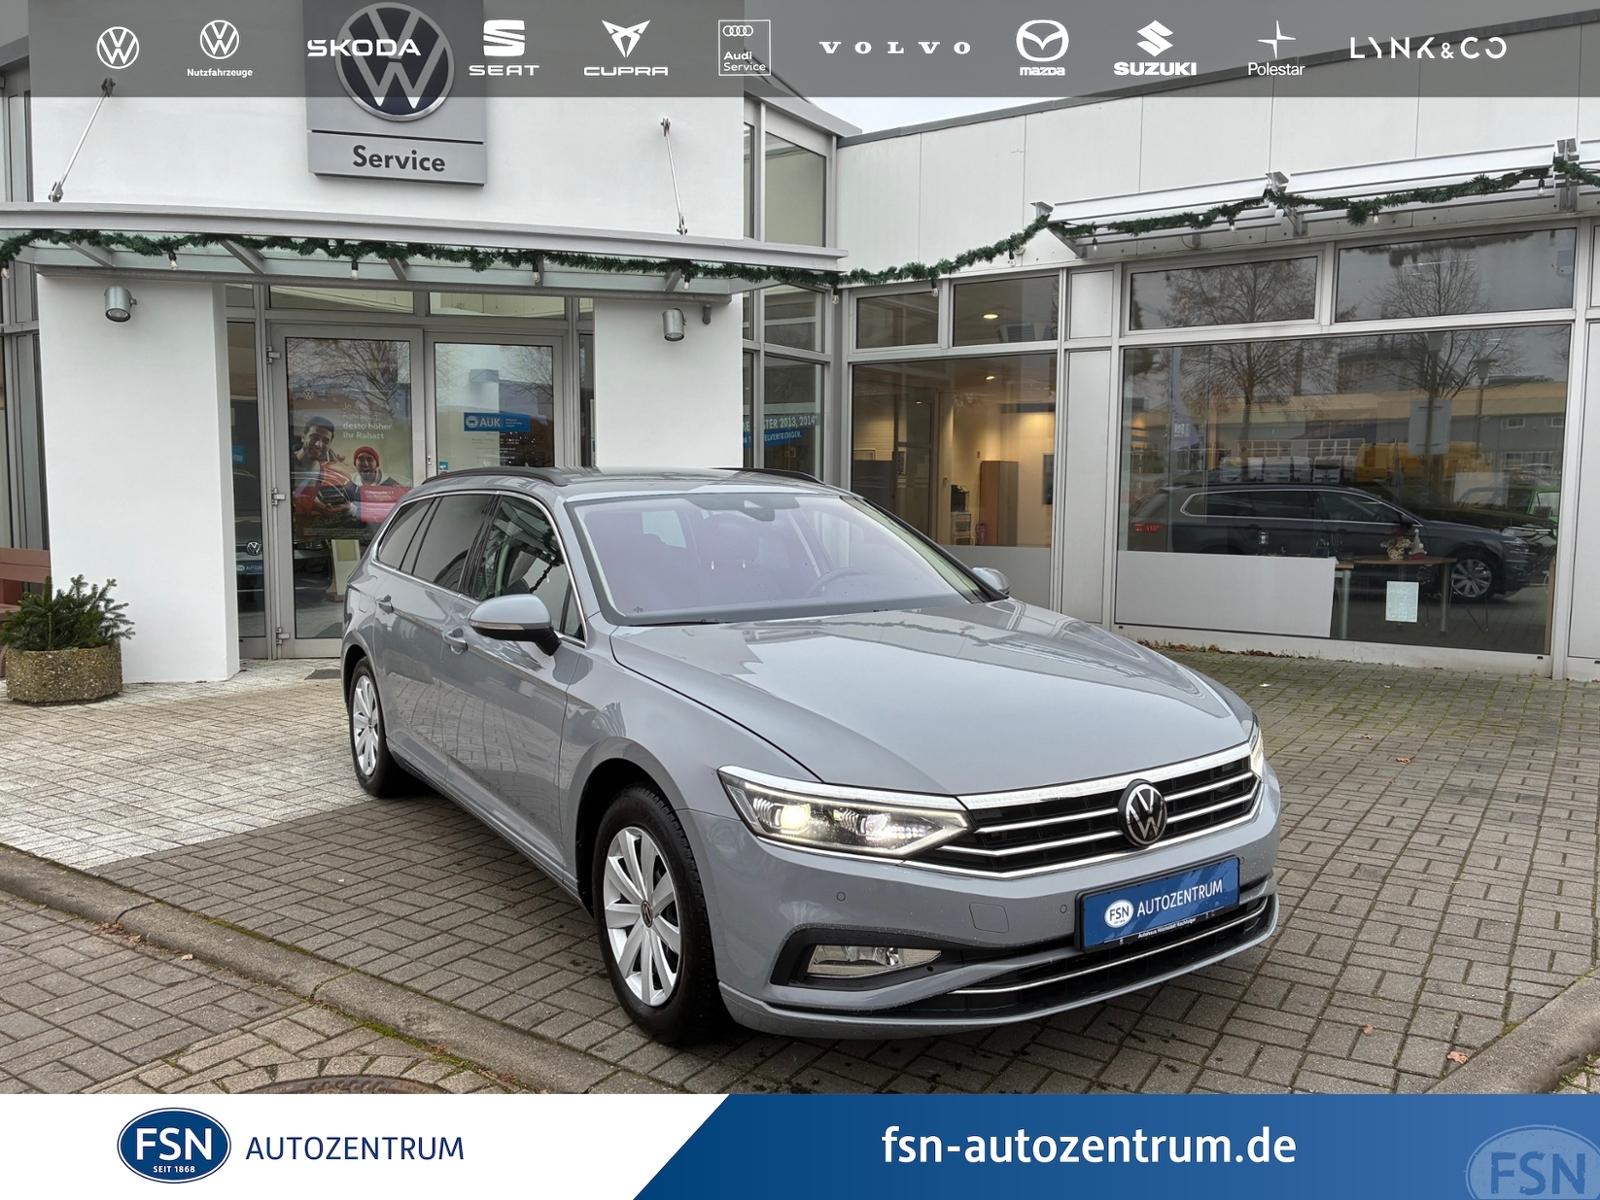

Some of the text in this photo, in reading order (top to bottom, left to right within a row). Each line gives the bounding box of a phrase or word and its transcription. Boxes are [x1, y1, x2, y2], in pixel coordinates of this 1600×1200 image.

[353, 144, 447, 172] Service
[479, 417, 502, 428] AUK
[1108, 879, 1223, 922] FSN AUTOZENTRUM
